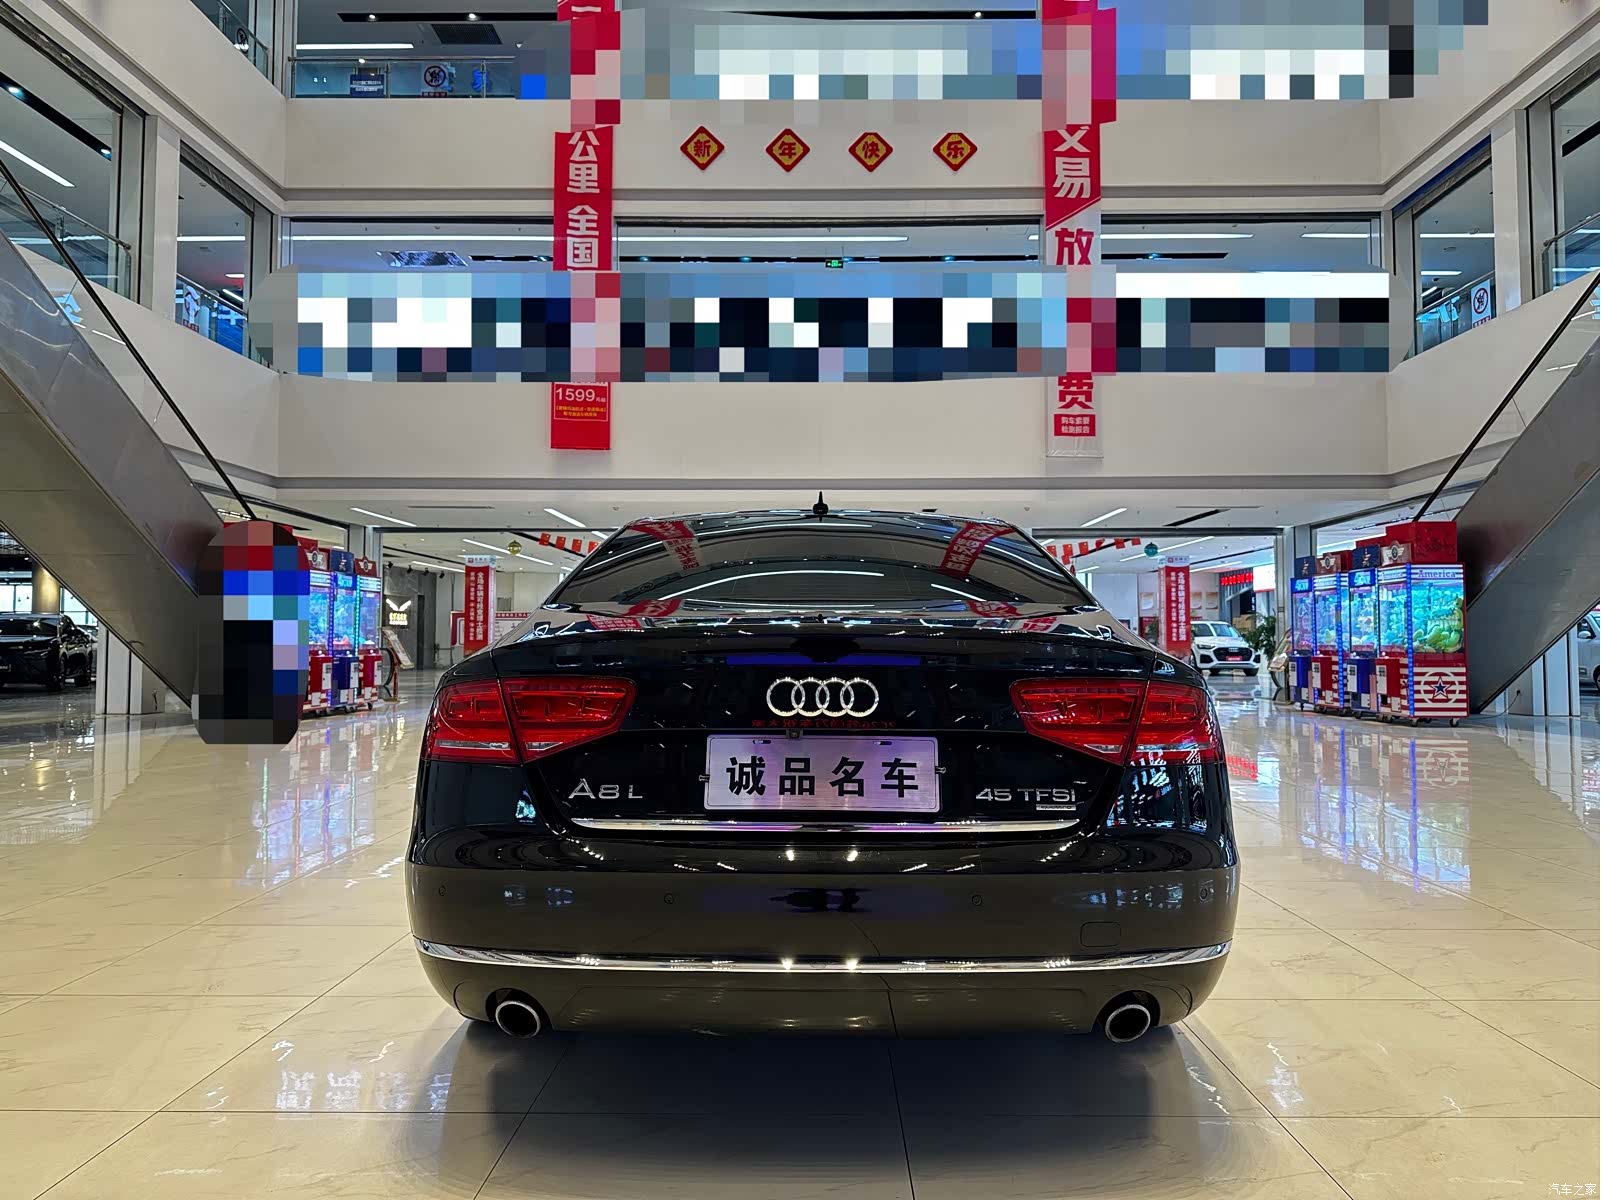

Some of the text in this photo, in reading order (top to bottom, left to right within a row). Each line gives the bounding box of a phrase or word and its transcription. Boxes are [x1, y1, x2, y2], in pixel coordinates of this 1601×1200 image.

[567, 130, 601, 193] 公里
[1055, 227, 1095, 266] 放
[1417, 569, 1456, 579] America
[726, 755, 919, 798] 诚品名车
[975, 788, 1076, 802] 45 TFSI
